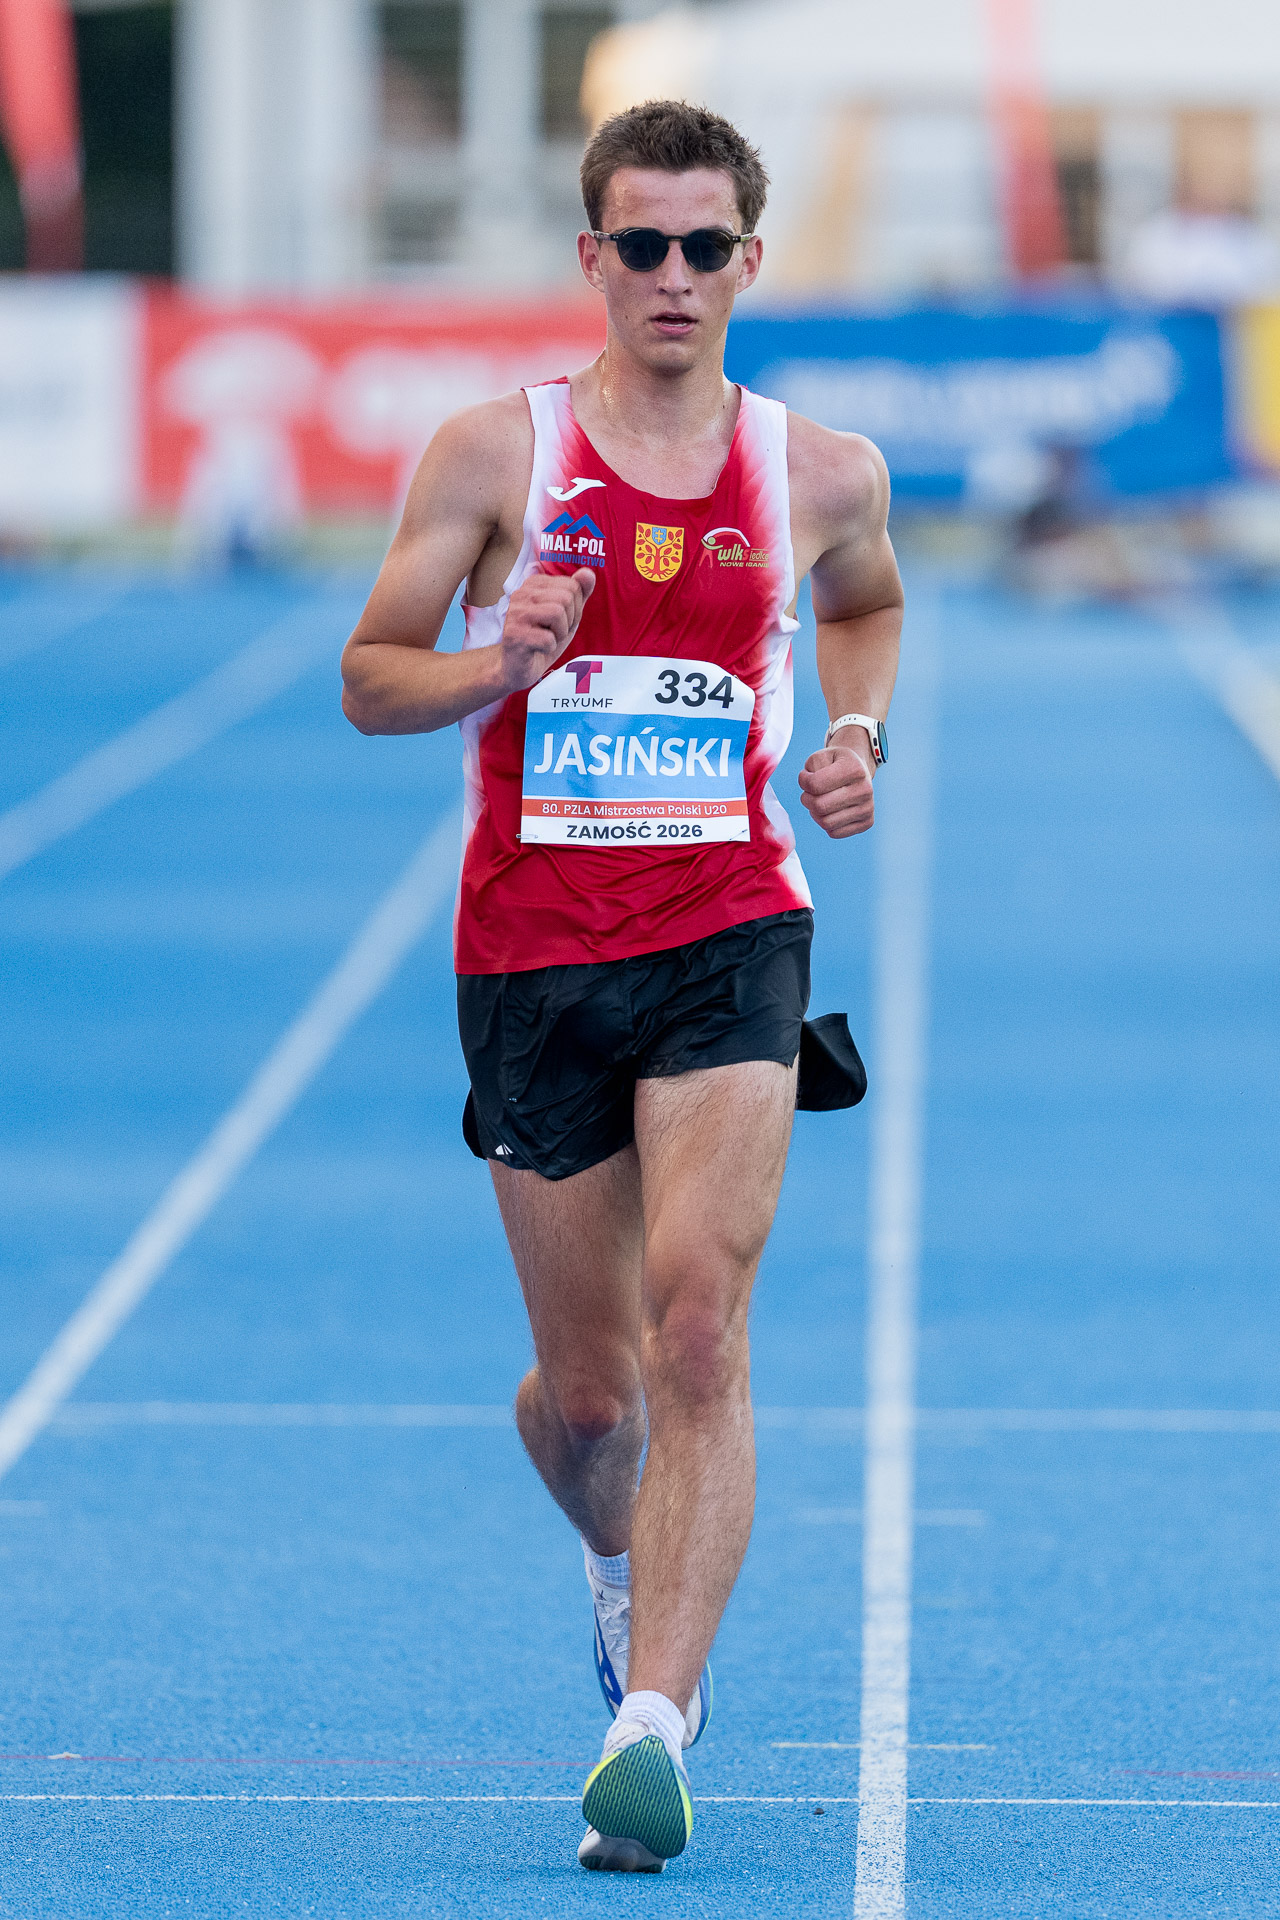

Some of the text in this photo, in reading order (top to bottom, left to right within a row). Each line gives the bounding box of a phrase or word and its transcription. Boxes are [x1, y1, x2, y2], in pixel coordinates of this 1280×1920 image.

[541, 533, 606, 557] MAL-POL
[540, 551, 606, 568] BUDOWNICTWO
[654, 669, 735, 709] 334
[551, 698, 614, 708] TRYUMF
[533, 726, 732, 777] JASIŃSKI
[542, 803, 727, 816] 80. PZLA Mistrzostwa Polski U20
[566, 821, 703, 839] ZAMOŚĆ 2026
